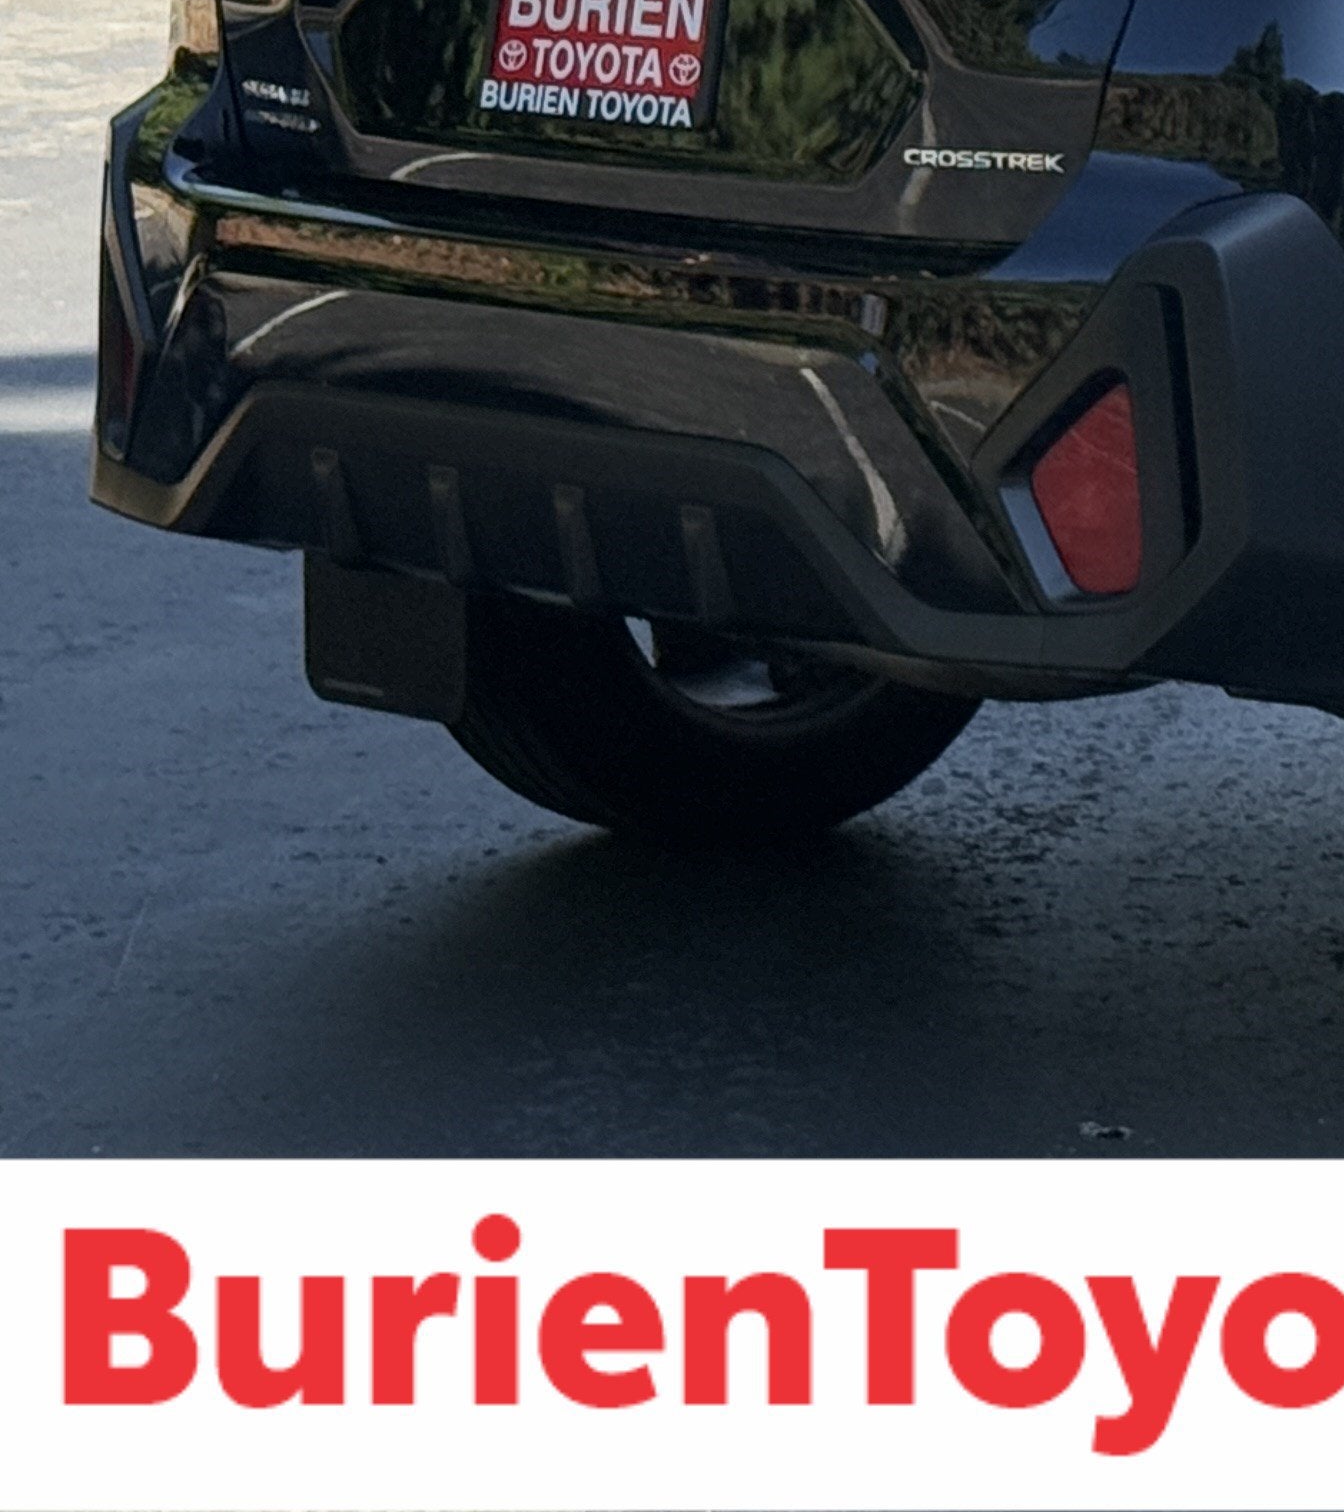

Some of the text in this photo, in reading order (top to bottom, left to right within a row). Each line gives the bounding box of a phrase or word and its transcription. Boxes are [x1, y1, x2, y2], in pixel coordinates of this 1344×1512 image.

[533, 38, 663, 88] TOYOTA
[480, 79, 692, 128] BURIEN TOYOTA
[903, 148, 1066, 174] CROSSTREK
